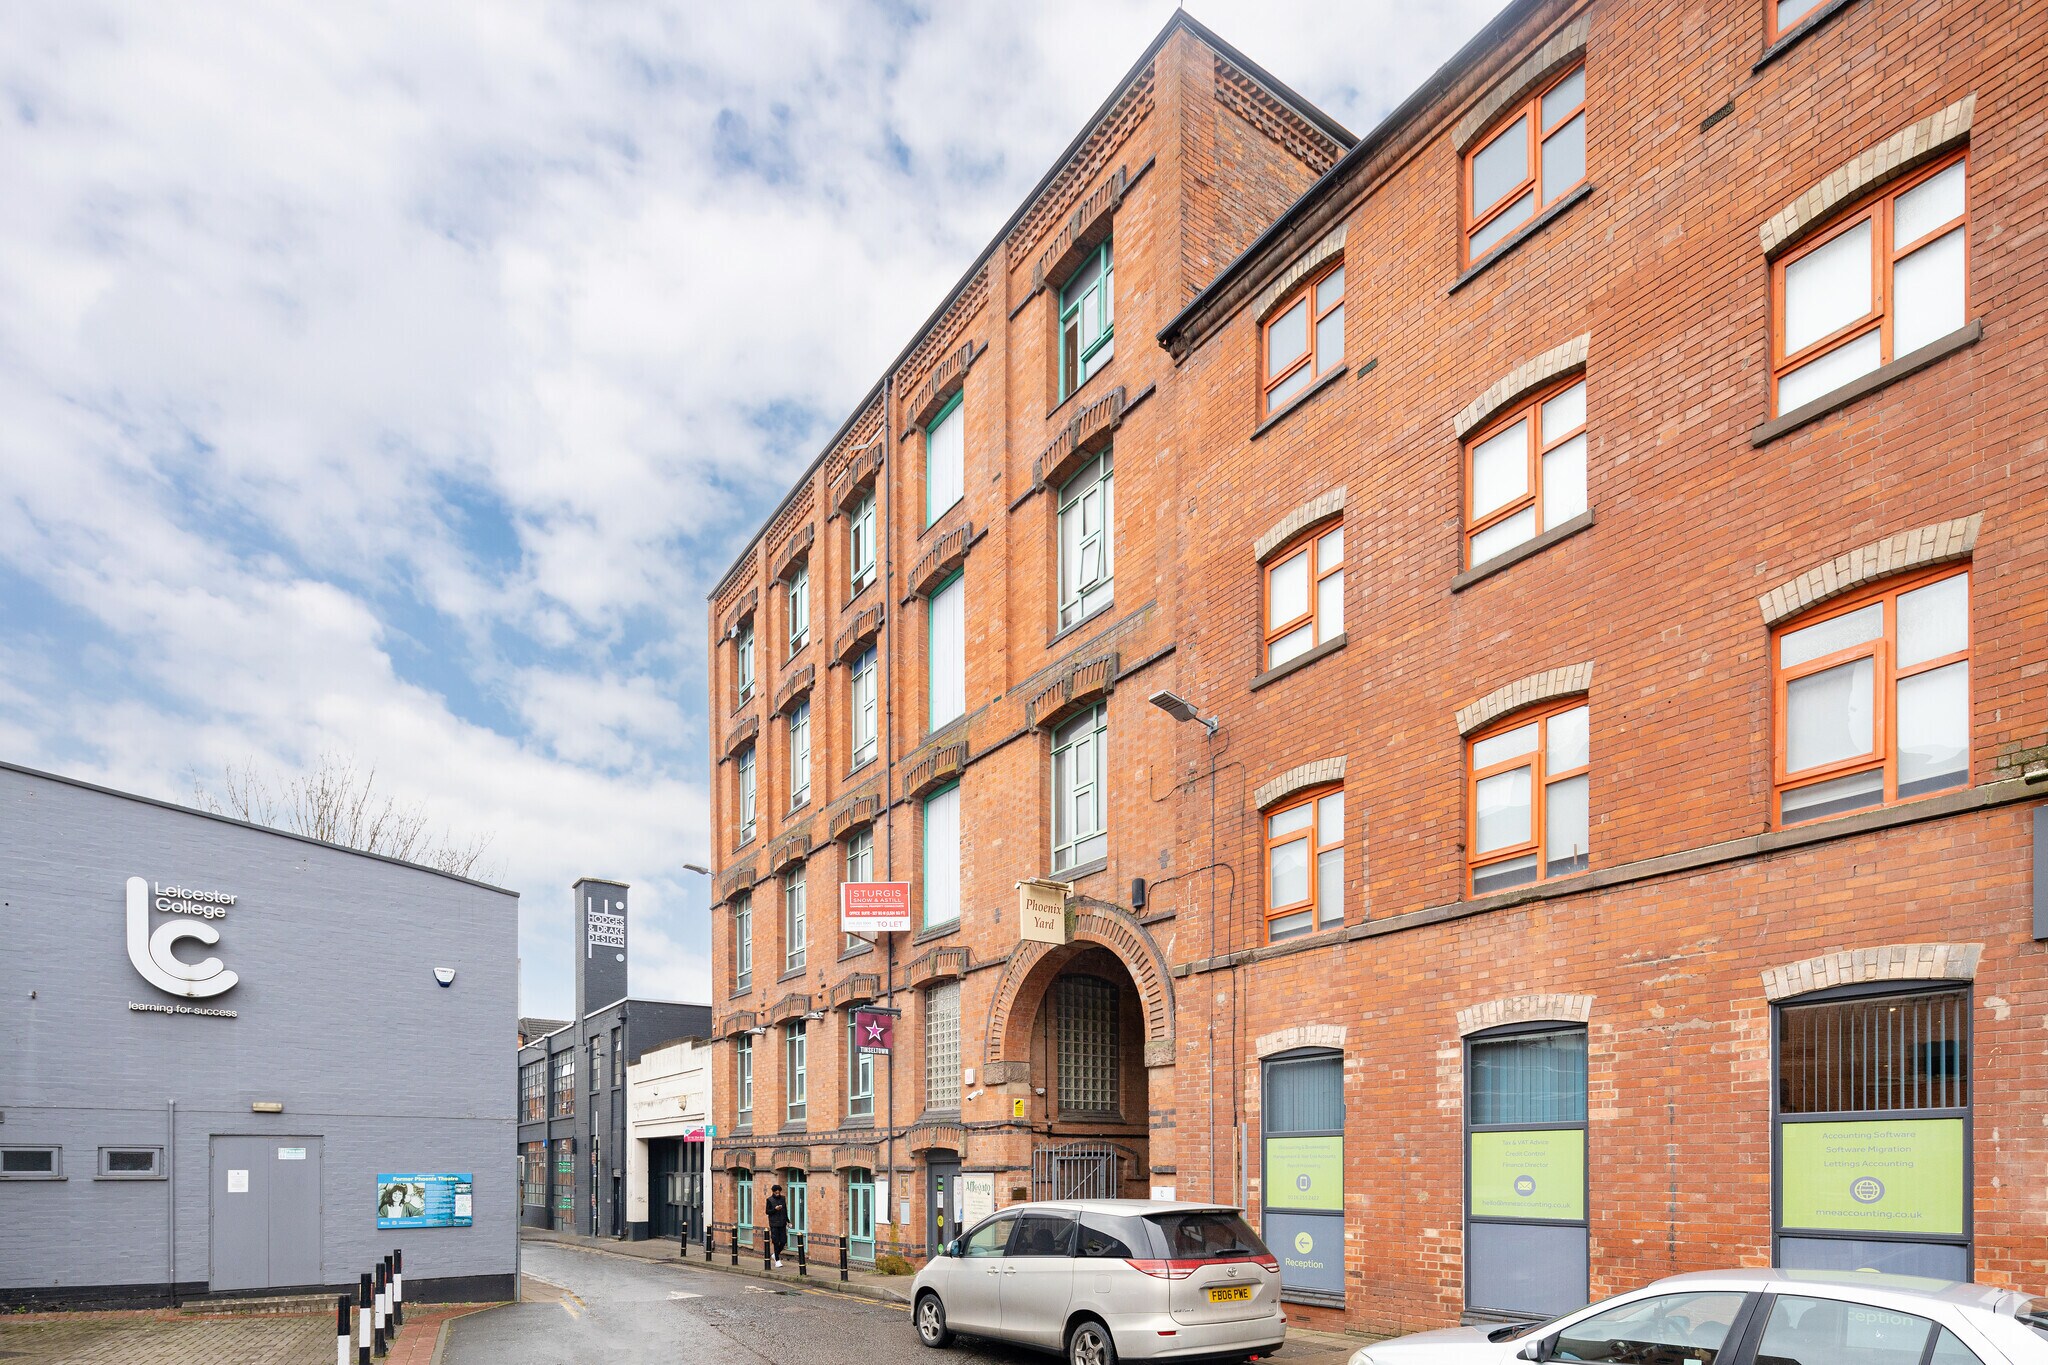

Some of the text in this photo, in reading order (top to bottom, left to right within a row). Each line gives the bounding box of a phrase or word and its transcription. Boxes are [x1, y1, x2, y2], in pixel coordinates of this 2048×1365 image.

[155, 882, 238, 905] Leicester
[853, 889, 902, 898] STURGIS
[156, 897, 226, 919] College
[1026, 898, 1062, 915] Phoenix
[588, 914, 625, 926] HODGES
[1034, 916, 1055, 930] Yard
[597, 925, 625, 935] DRAKE
[588, 934, 625, 946] DESIGN
[128, 1001, 238, 1017] learning for success
[1822, 1132, 1872, 1140] Accounting
[1867, 1145, 1912, 1154] Migration
[1824, 1160, 1914, 1168] Lettings Accounting
[1481, 1200, 1570, 1208] hello@mneaccounting.co.uk
[1816, 1209, 1923, 1220] mneaccounting.co.uk
[1285, 1258, 1324, 1270] Reception
[1211, 1288, 1249, 1301] FB06 PWE
[1848, 1311, 1913, 1326] ception
